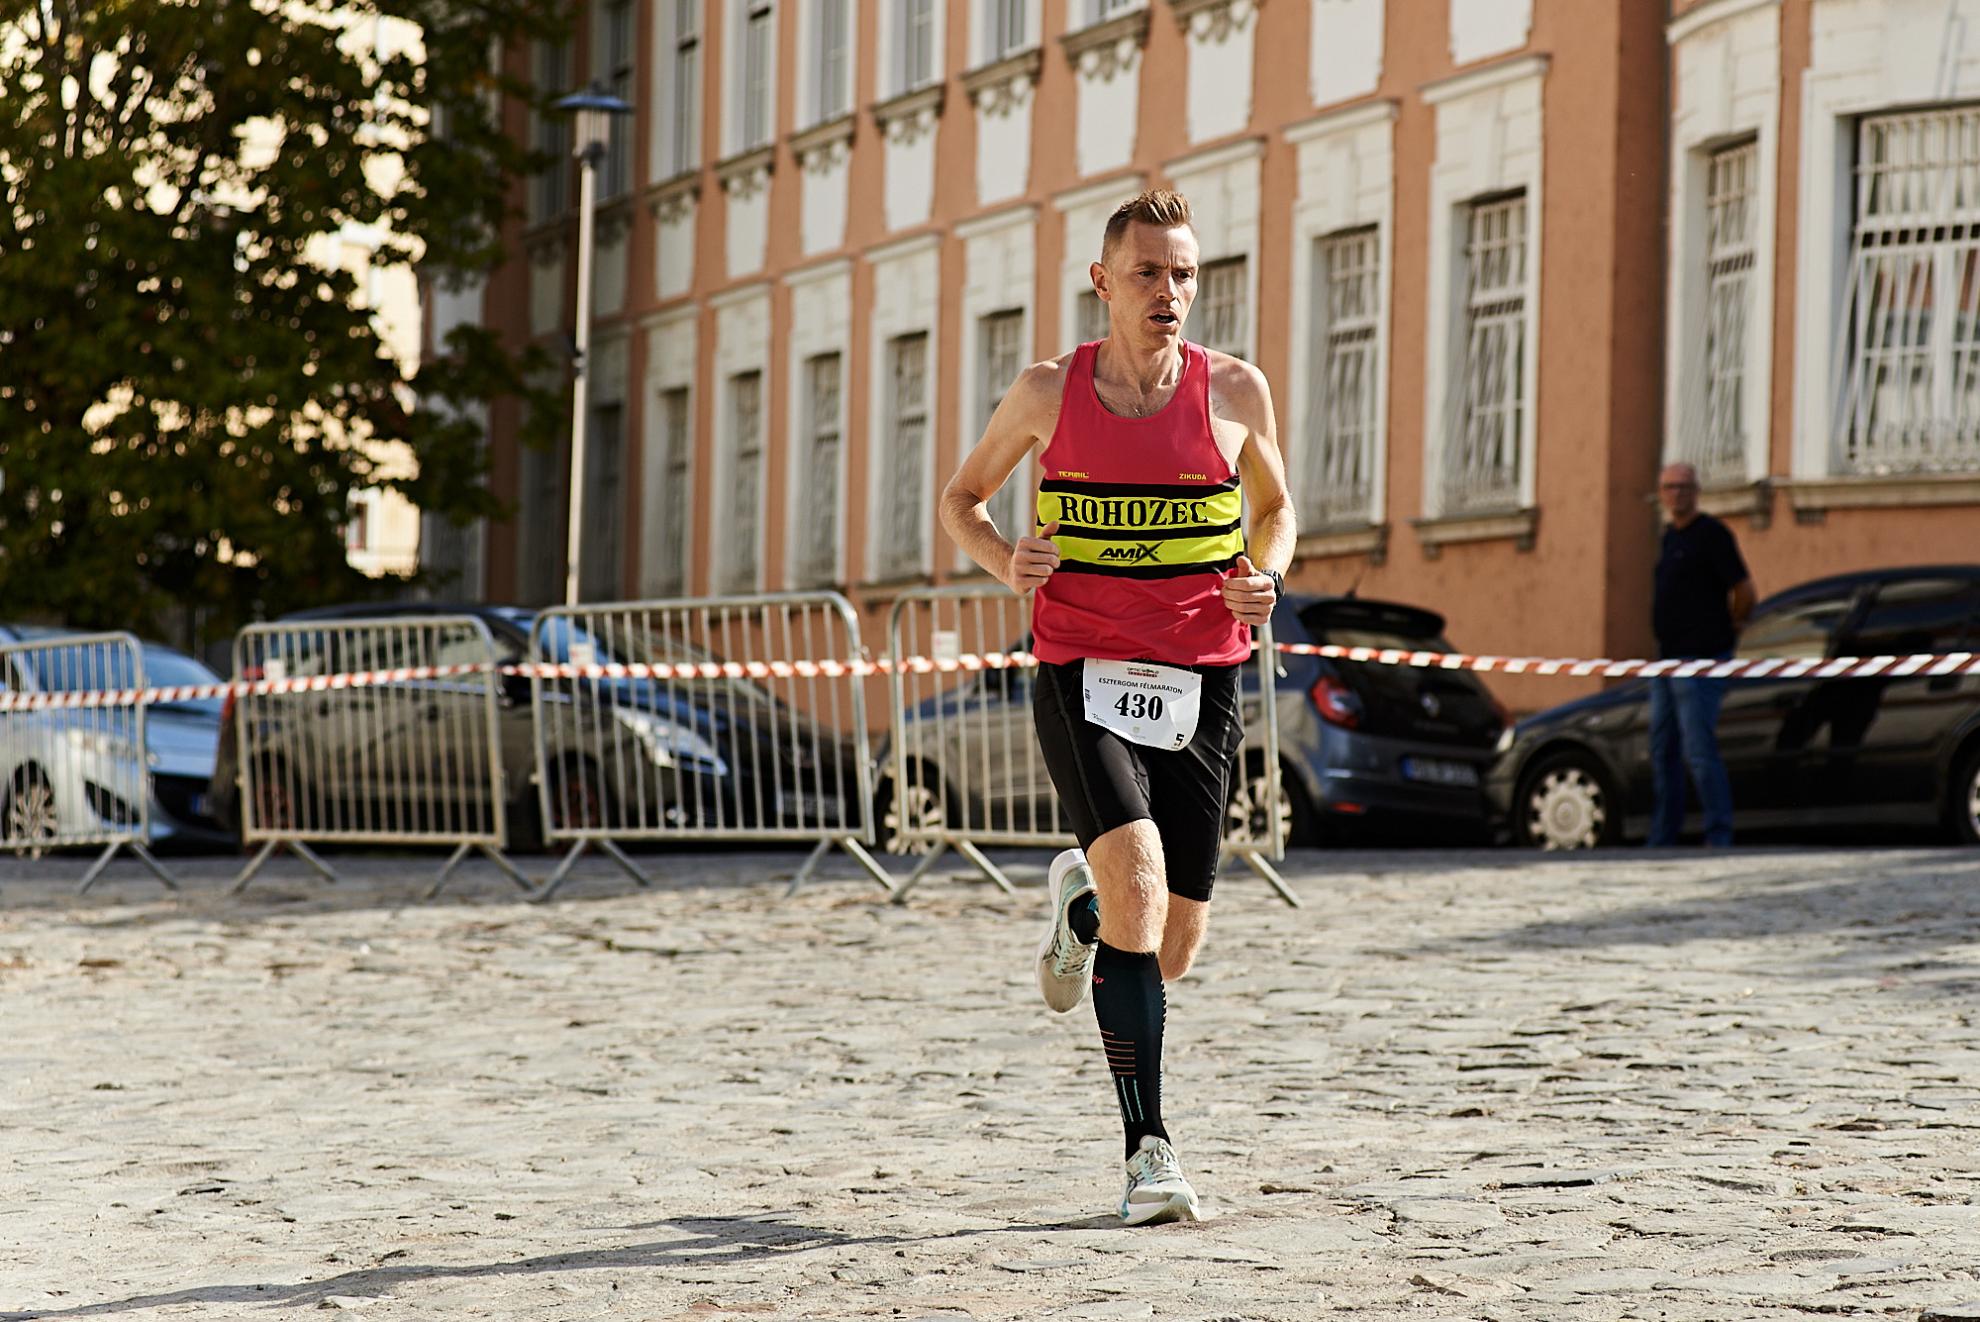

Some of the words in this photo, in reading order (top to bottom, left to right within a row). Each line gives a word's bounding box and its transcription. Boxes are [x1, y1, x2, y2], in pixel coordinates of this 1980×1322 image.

[1178, 473, 1207, 481] ZIKUDA
[1057, 495, 1208, 526] ROHOZEC
[1098, 541, 1164, 565] AMIX
[1140, 682, 1183, 695] FÉLMARATON
[1114, 691, 1163, 721] 430
